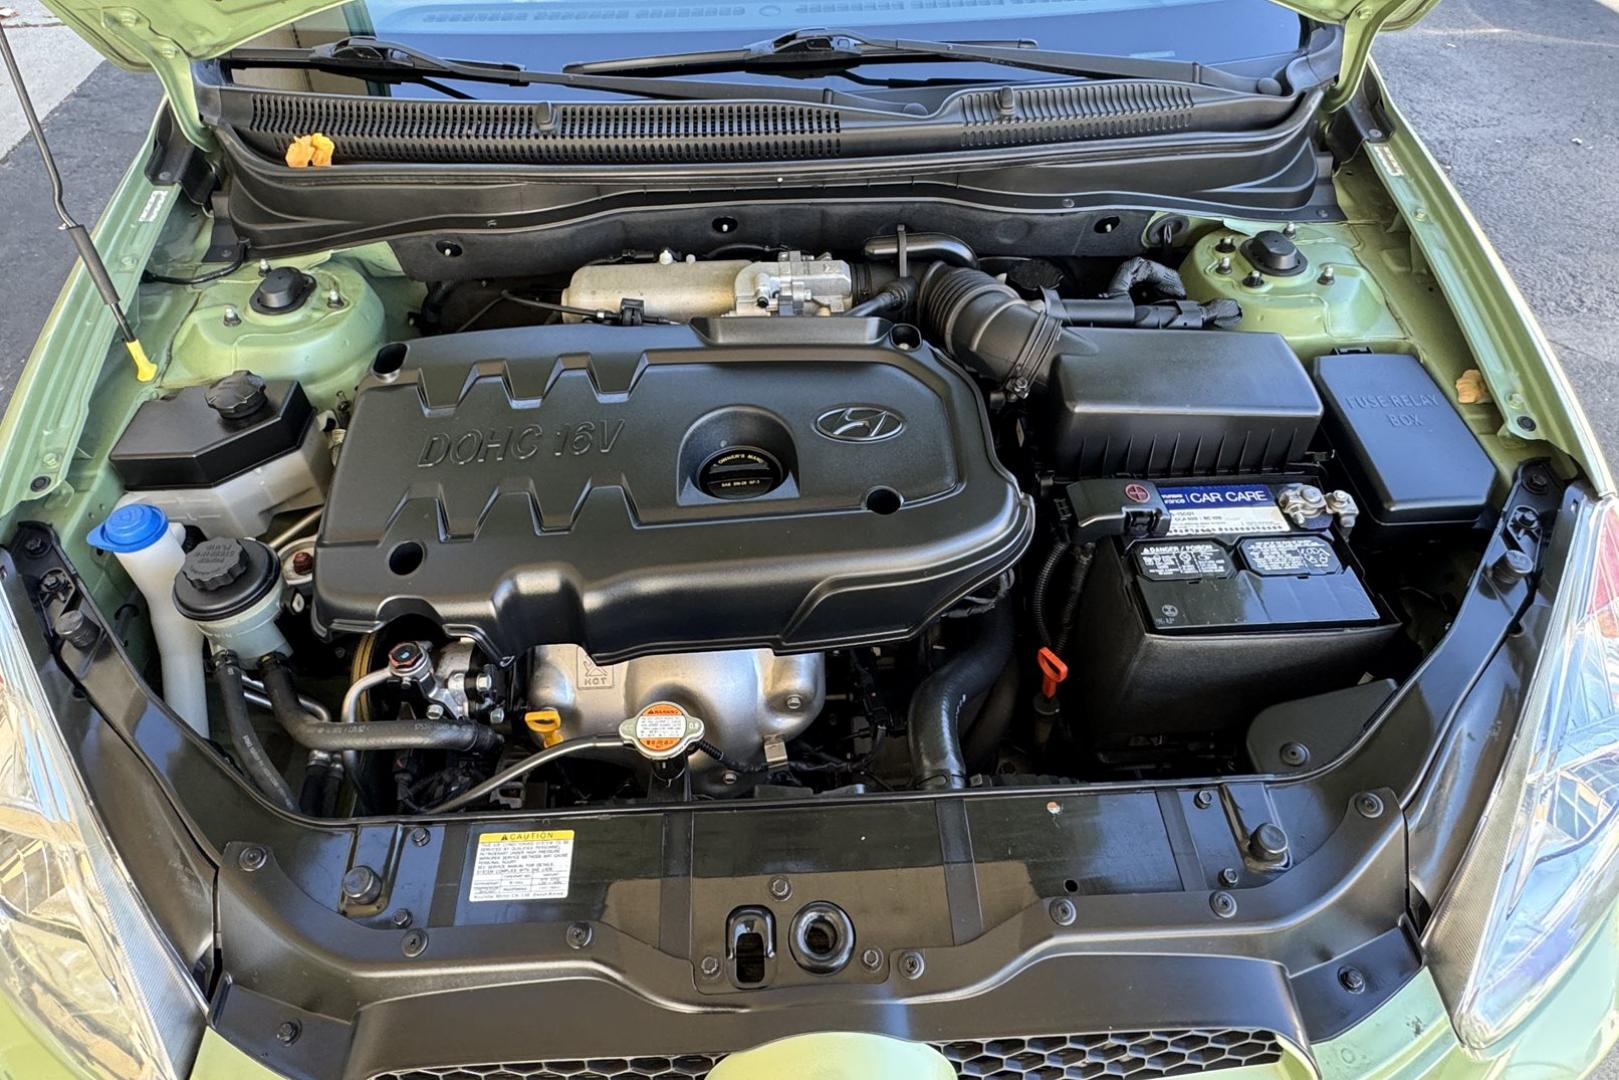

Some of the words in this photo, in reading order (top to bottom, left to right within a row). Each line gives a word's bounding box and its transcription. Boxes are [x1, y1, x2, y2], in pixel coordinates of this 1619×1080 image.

[1344, 394, 1387, 409] FUSE
[1388, 393, 1439, 408] RELAY
[1386, 413, 1422, 428] BOX
[417, 424, 543, 468] DOHC
[553, 418, 625, 456] 16V
[1190, 492, 1224, 504] CAR
[1225, 490, 1269, 502] CARE
[584, 677, 607, 686] HOT
[510, 832, 553, 841] CAUTION
